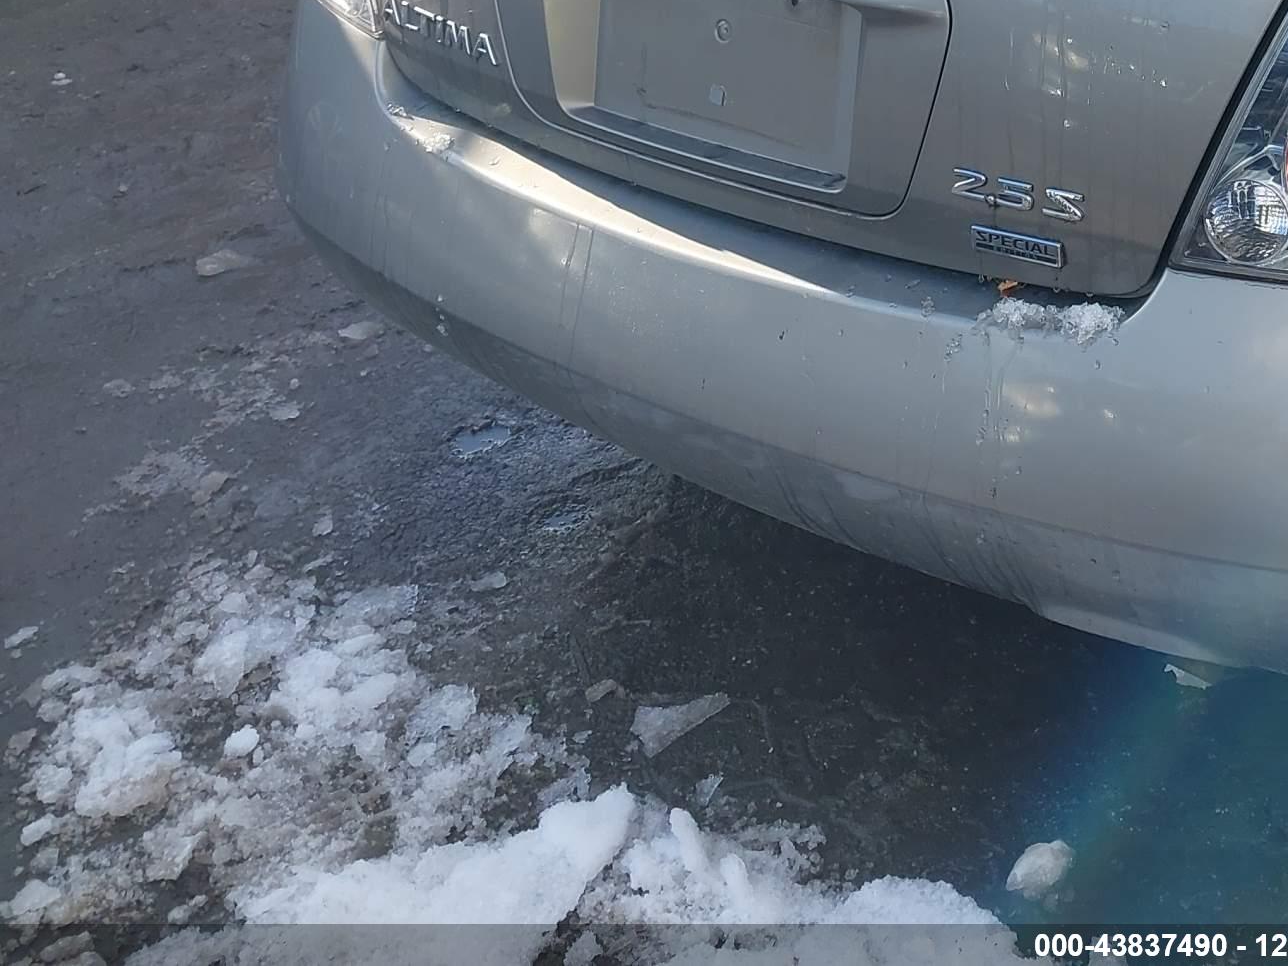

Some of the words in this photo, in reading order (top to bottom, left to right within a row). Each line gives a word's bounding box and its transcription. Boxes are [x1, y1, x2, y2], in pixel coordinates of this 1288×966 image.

[951, 166, 1034, 211] 2.5
[1041, 187, 1086, 222] S
[975, 230, 1056, 257] SPECIAL
